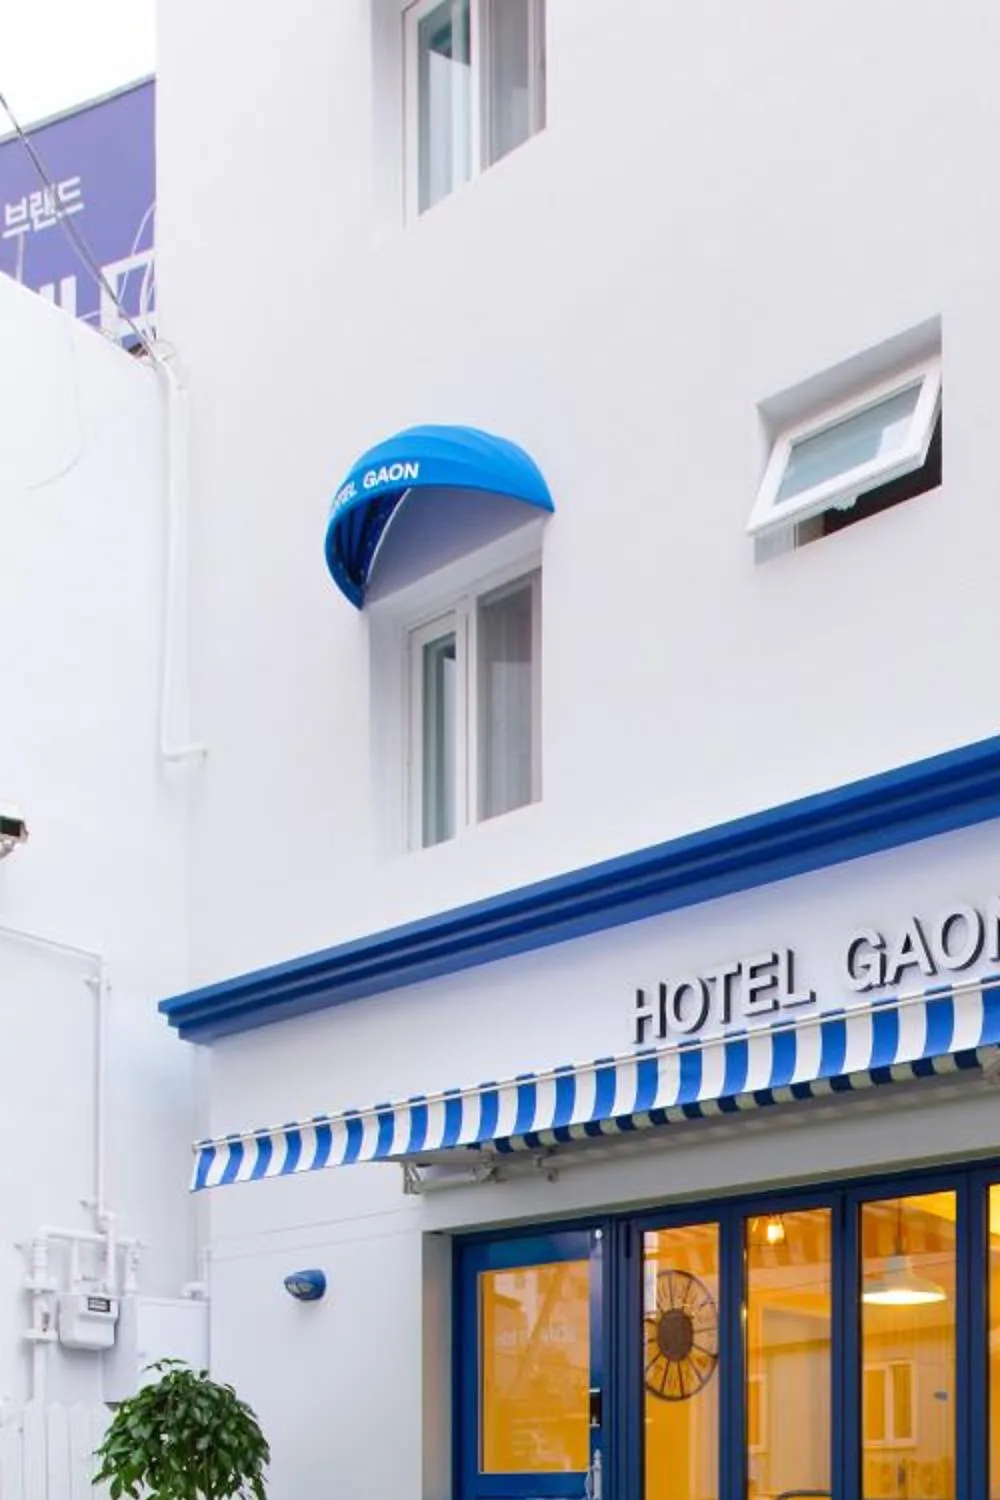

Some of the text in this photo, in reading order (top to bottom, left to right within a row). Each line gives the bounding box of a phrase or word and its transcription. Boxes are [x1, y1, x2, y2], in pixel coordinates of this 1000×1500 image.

[2, 176, 84, 238] 브랜드
[363, 462, 420, 489] GAON
[632, 946, 817, 1044] HOTEL
